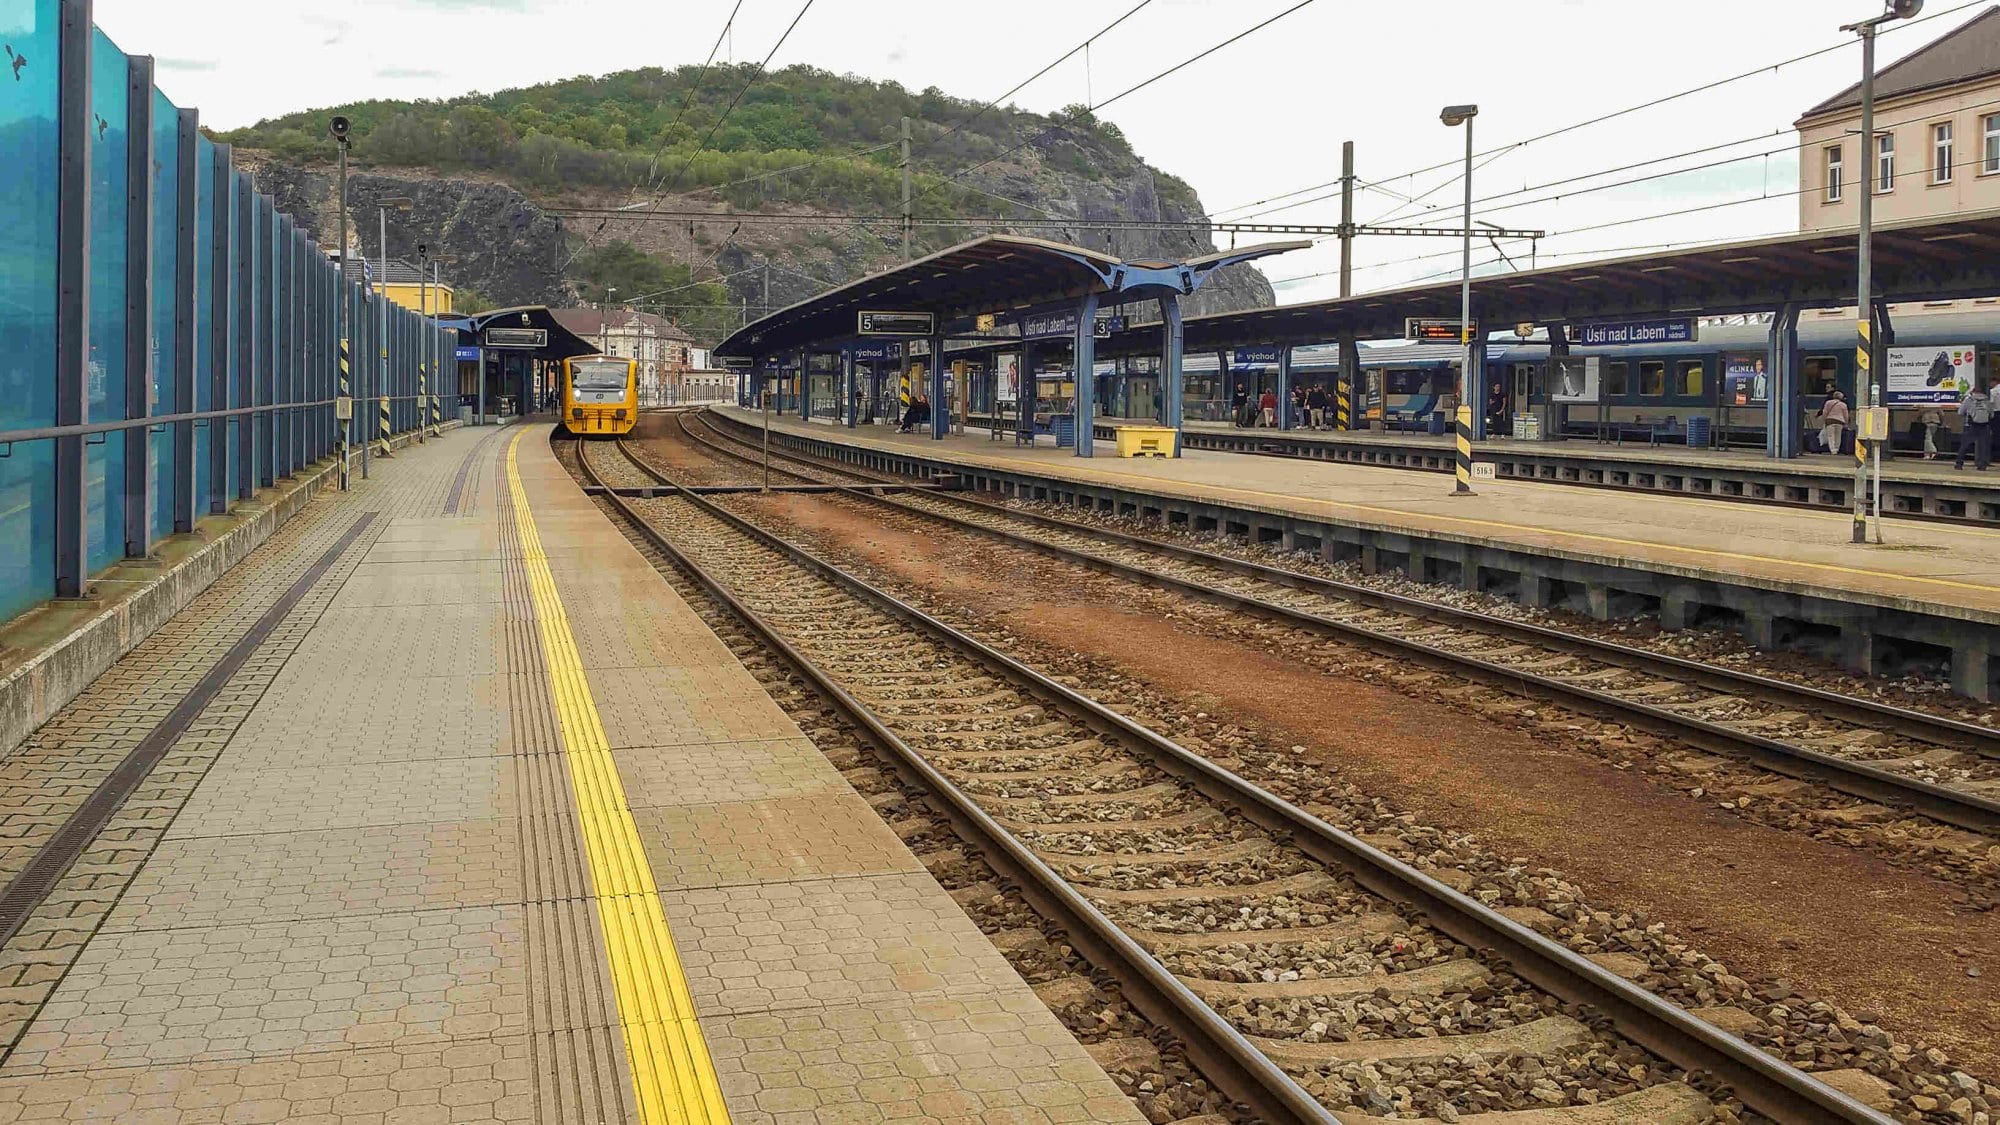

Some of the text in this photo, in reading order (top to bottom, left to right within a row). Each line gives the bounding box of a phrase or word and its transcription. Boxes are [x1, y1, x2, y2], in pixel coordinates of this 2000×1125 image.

[863, 318, 872, 330] 5
[1047, 316, 1065, 333] Labem
[1098, 322, 1106, 334] 3
[1413, 325, 1418, 336] 1
[1586, 324, 1665, 343] Ústí nad Labem
[535, 334, 542, 343] 7
[1246, 352, 1275, 362] východ
